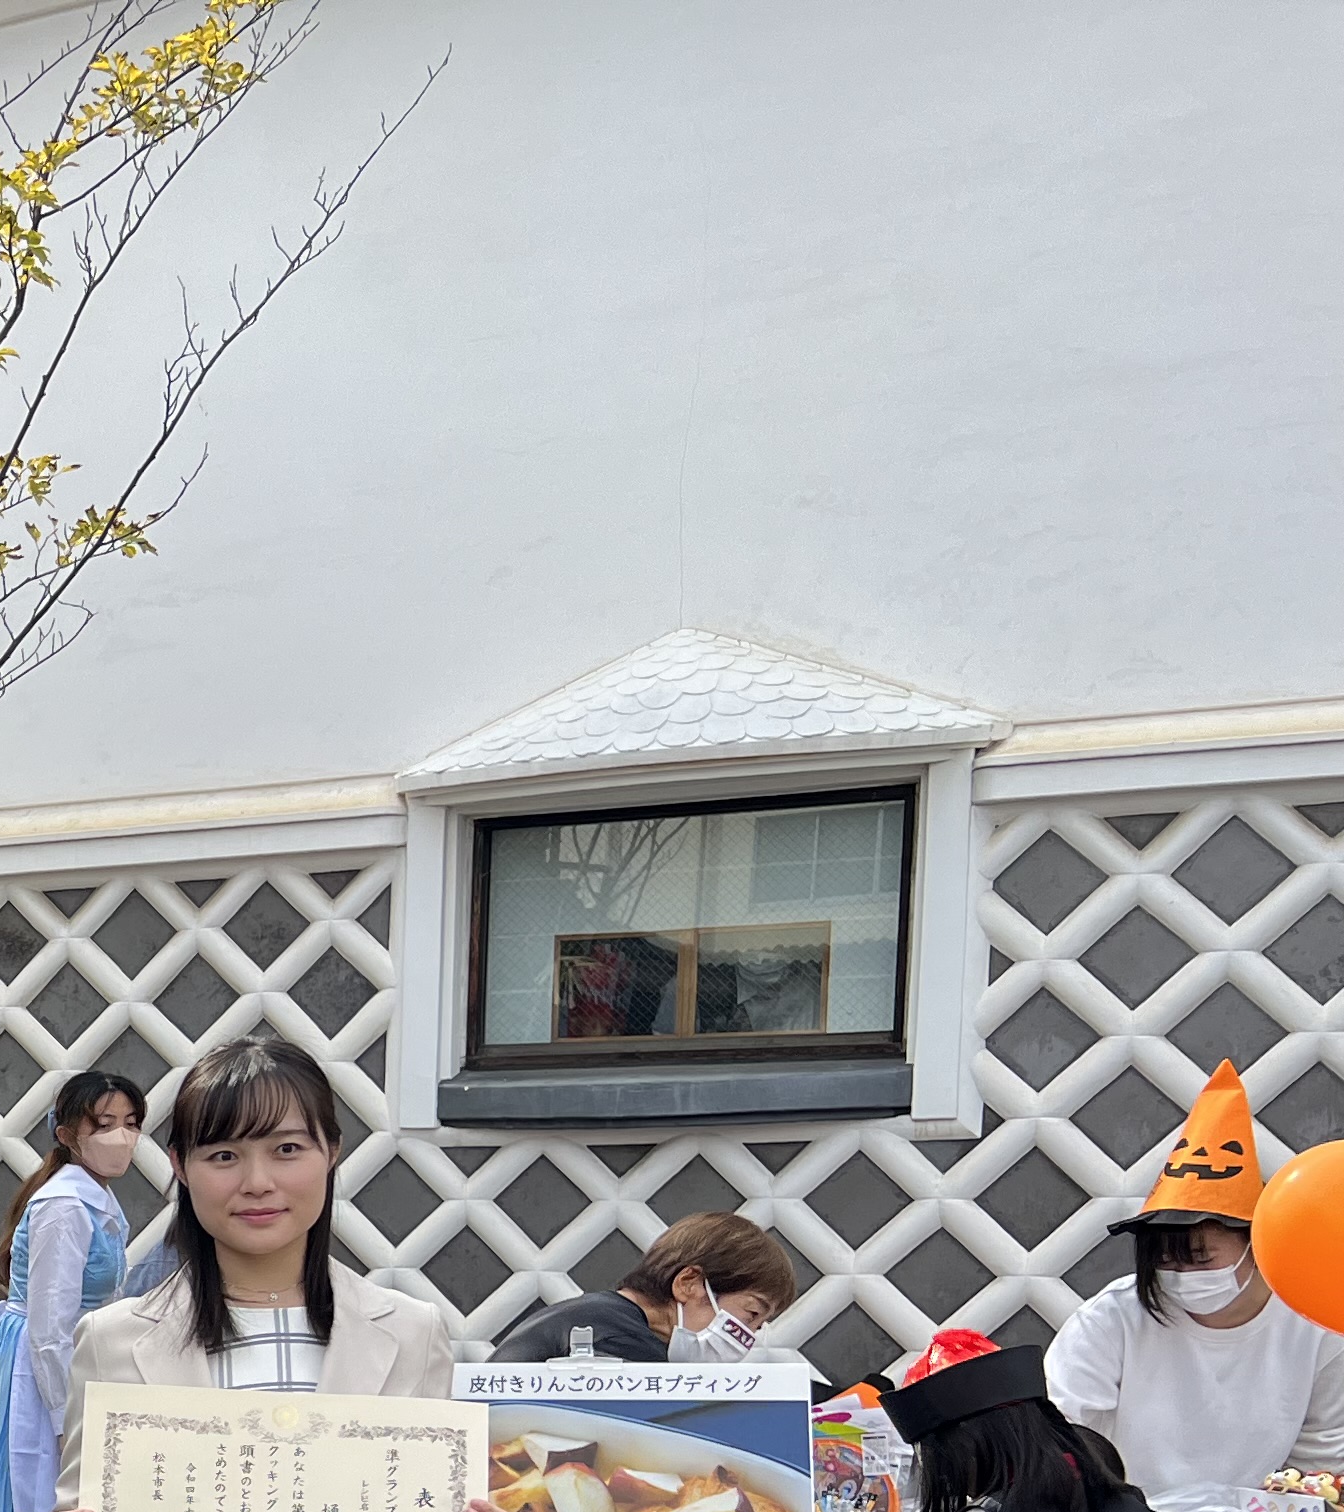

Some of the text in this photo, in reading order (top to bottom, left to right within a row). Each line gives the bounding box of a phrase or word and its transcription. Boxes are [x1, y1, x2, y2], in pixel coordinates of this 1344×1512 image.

[468, 1374, 762, 1395] 皮付きりんごのパン耳プディング
[152, 1451, 166, 1501] 松本市長
